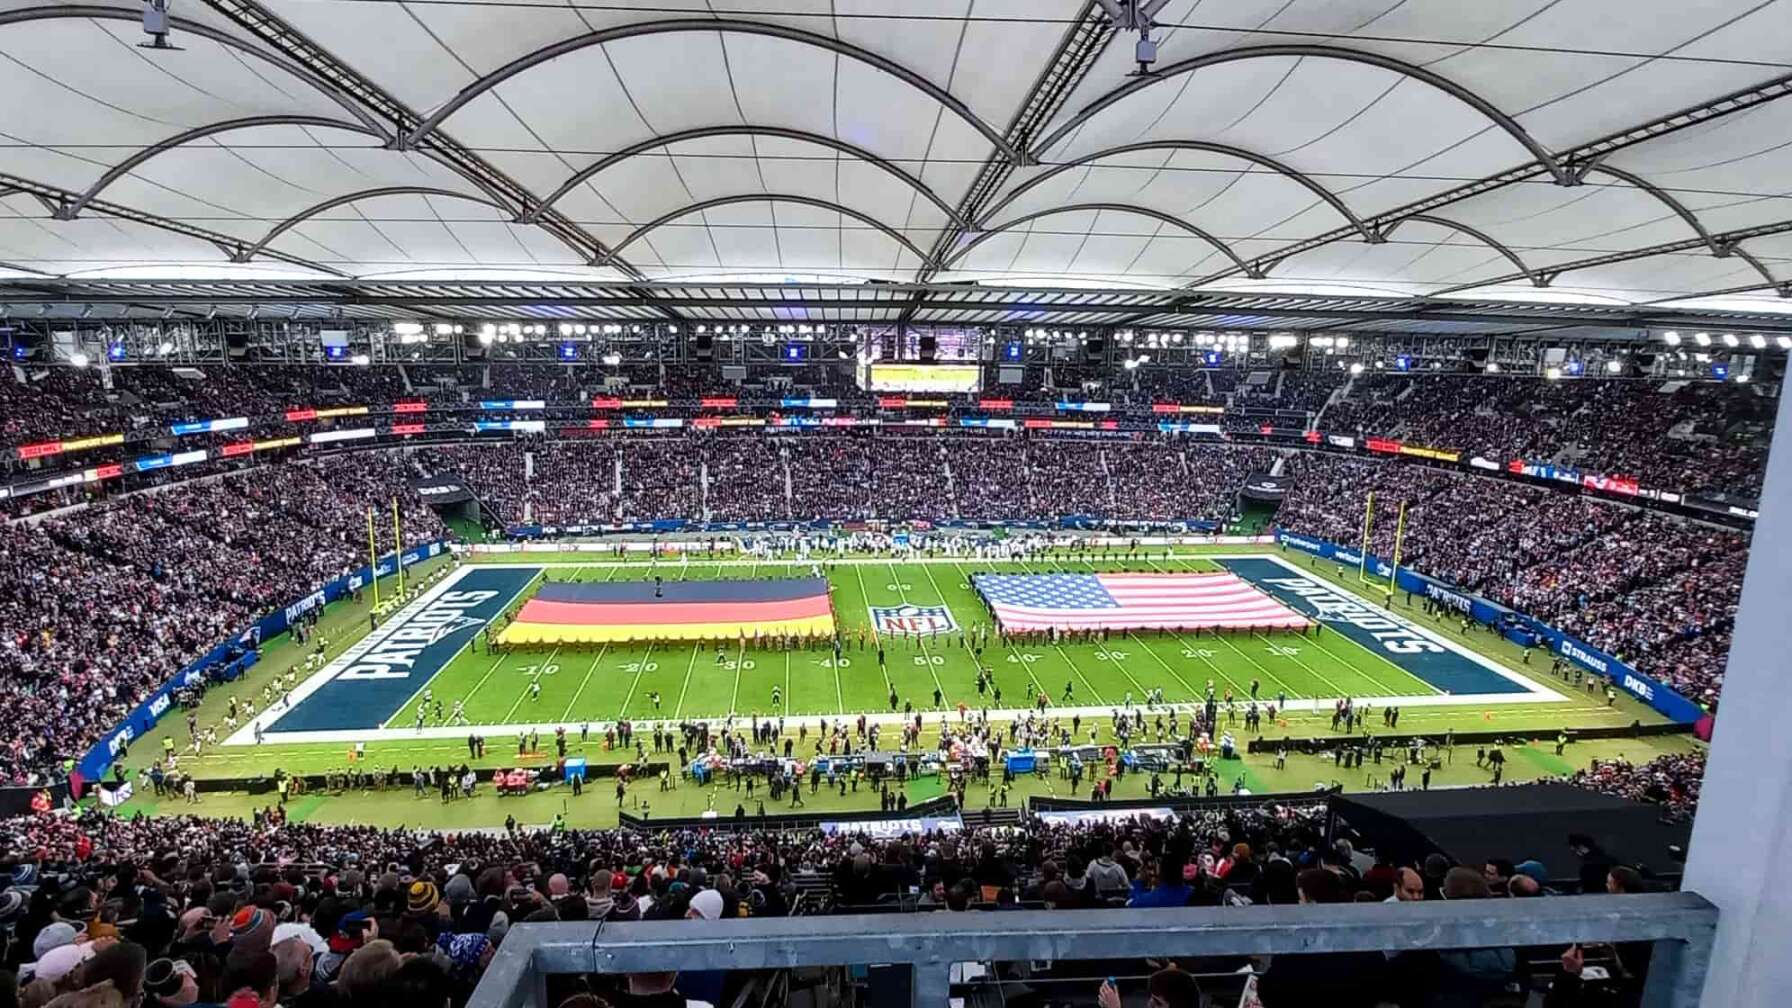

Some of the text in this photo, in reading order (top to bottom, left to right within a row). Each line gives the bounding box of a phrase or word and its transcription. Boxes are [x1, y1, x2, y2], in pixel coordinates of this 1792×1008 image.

[1261, 578, 1445, 653] PATRIOTS
[884, 617, 946, 632] NFL
[336, 590, 500, 680] PATRIOTS
[723, 660, 755, 670] 30
[820, 658, 850, 668] 40
[914, 656, 945, 666] 50
[1571, 647, 1607, 672] STRAUSS
[625, 663, 658, 673] 20
[149, 693, 171, 717] VISA
[838, 819, 922, 832] PATRIOTS
